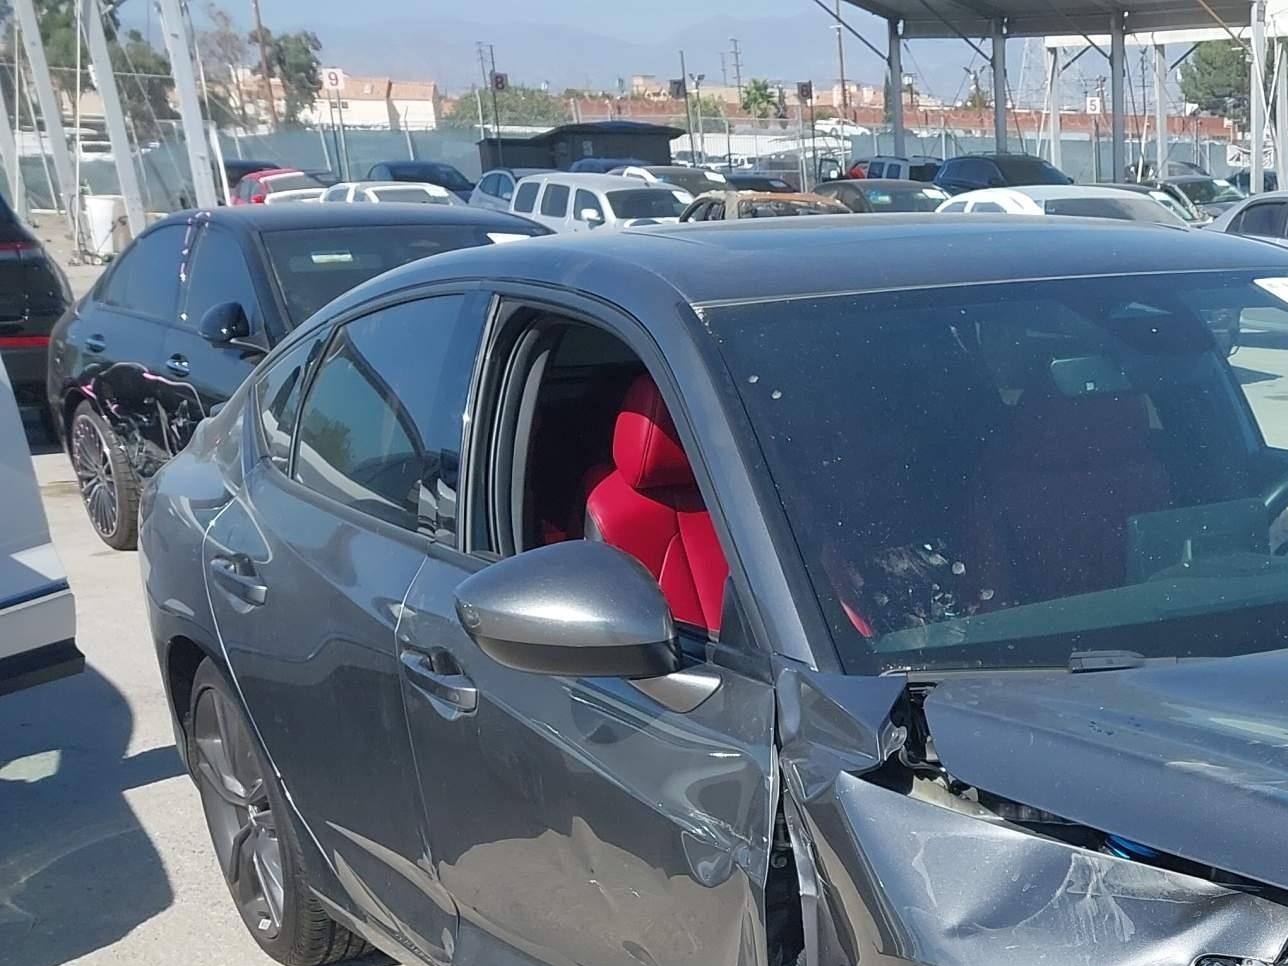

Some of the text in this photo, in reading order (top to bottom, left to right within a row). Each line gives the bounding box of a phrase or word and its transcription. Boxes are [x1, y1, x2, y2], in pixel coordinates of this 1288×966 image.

[327, 71, 339, 86] 9
[494, 74, 505, 90] 8
[674, 81, 683, 95] 7
[800, 84, 810, 98] 6
[1089, 97, 1098, 112] 5
